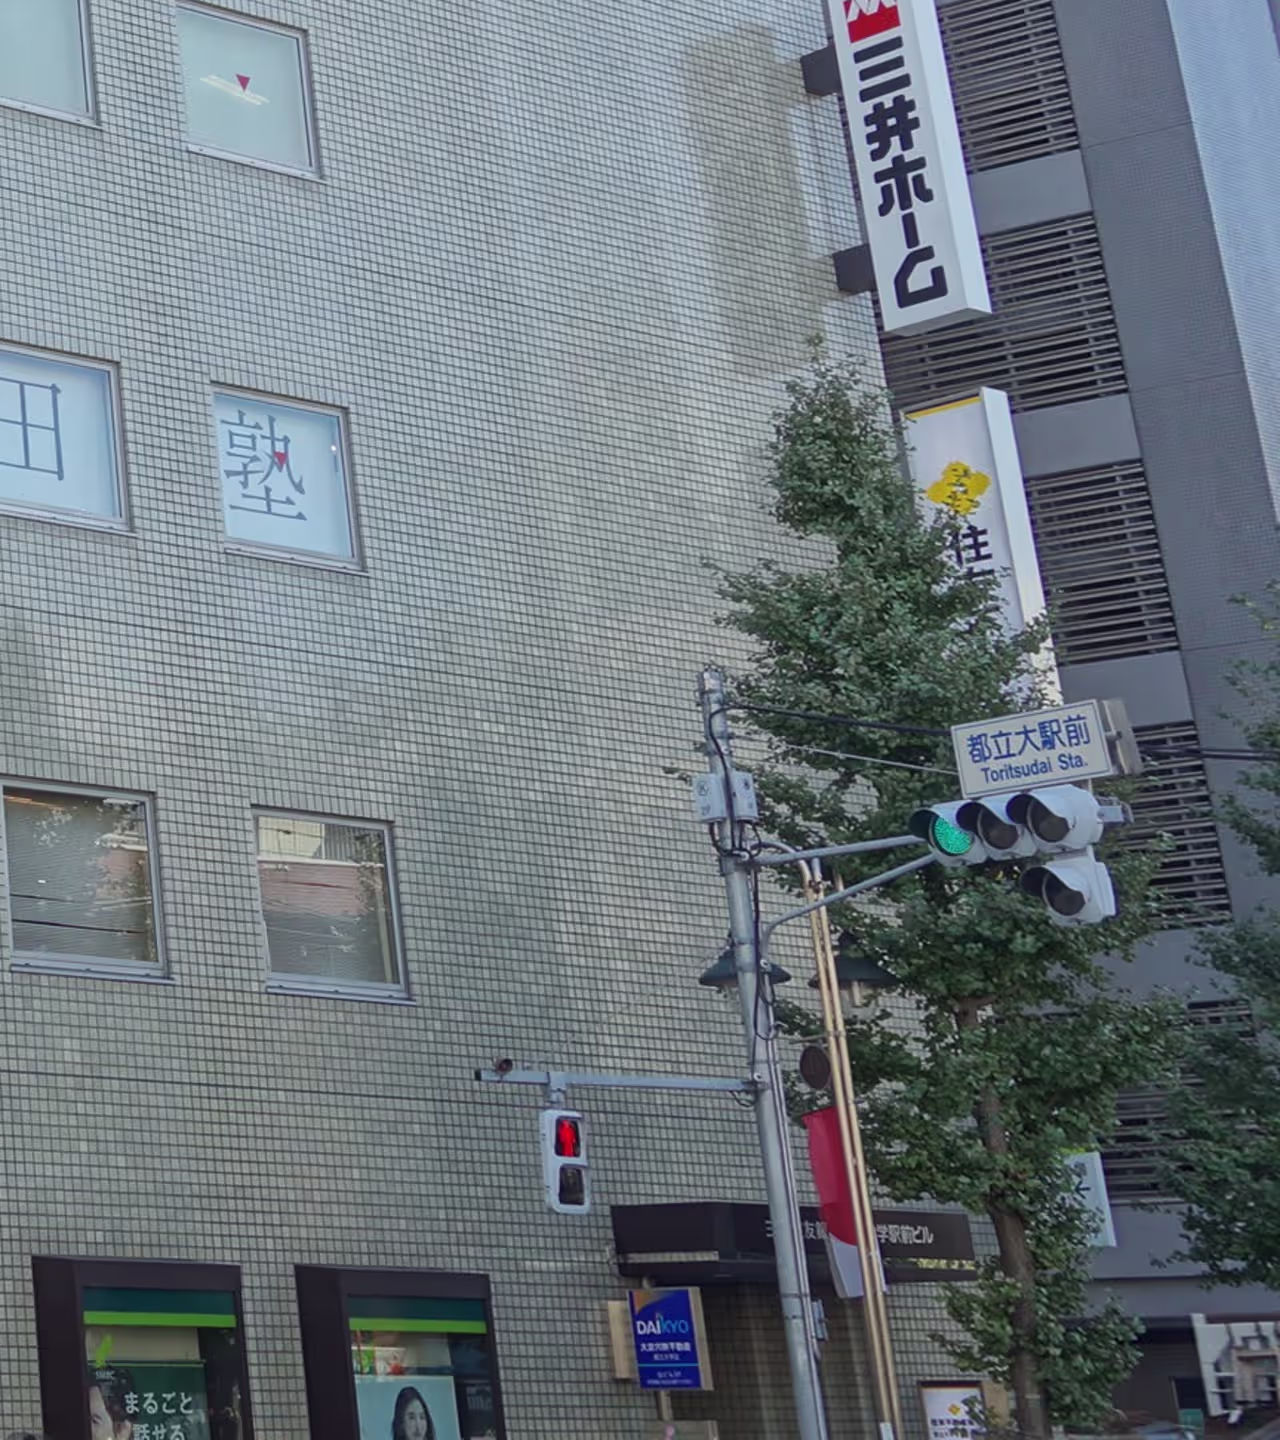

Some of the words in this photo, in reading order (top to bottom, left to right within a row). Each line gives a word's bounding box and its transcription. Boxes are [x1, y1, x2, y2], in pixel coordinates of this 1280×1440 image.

[853, 35, 948, 309] 三井ホーム
[966, 714, 1091, 764] 都立大駅前
[980, 757, 1053, 783] Toritsudai
[1057, 753, 1089, 771] Sta.
[124, 1391, 194, 1414] まるごと
[132, 1423, 187, 1440] 話せる
